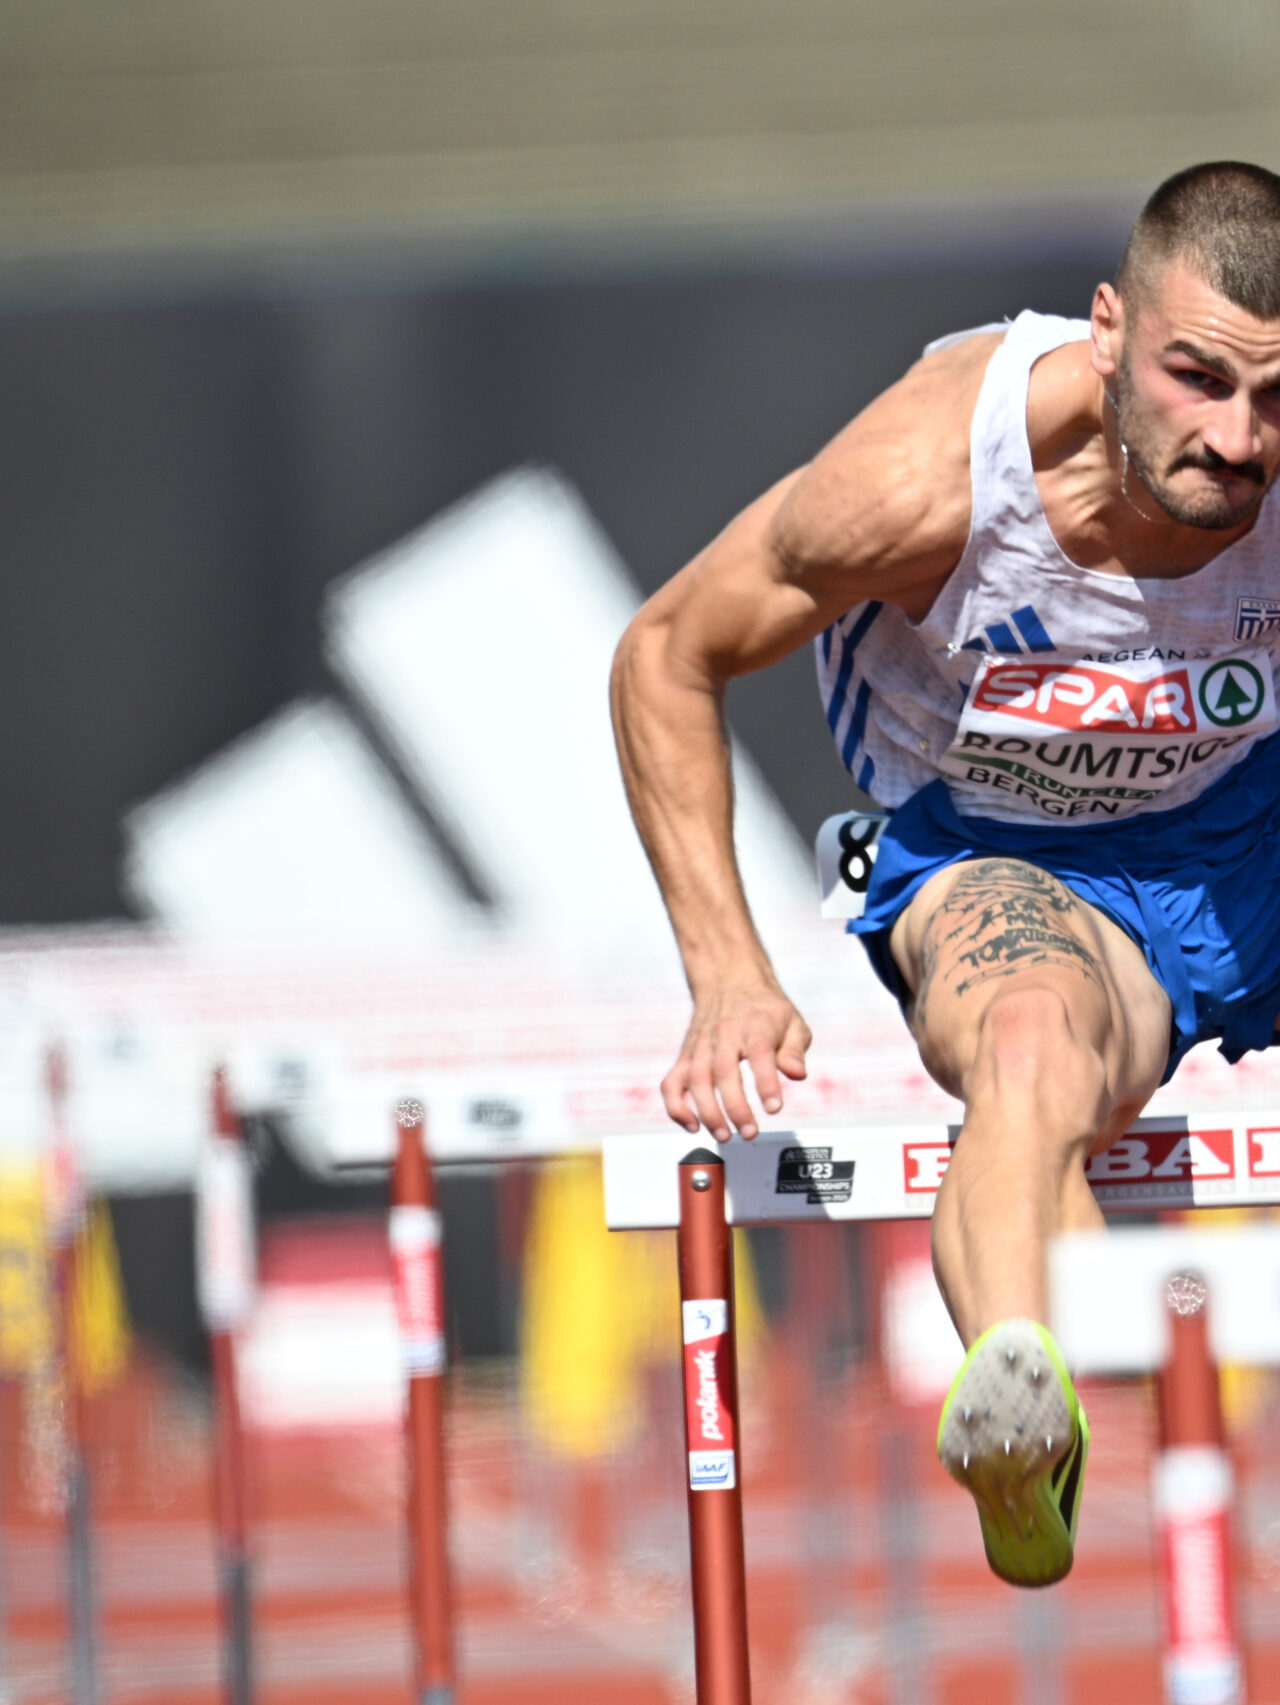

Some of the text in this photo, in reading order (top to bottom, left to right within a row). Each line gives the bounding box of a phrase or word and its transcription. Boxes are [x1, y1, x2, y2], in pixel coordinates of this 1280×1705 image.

[1081, 648, 1185, 664] AEGEAN
[982, 669, 1191, 729] SPAR
[966, 767, 1120, 817] BERGEN
[1023, 767, 1082, 799] RUN
[1089, 787, 1157, 799] CLEA
[838, 816, 881, 893] 8
[799, 1163, 833, 1179] U23
[908, 1147, 952, 1189] B
[1084, 1135, 1231, 1180] BA
[780, 1182, 850, 1192] CHAMPIONSHIPS
[1094, 1181, 1233, 1199] ERGENSAVISEN
[694, 1350, 724, 1440] polanik
